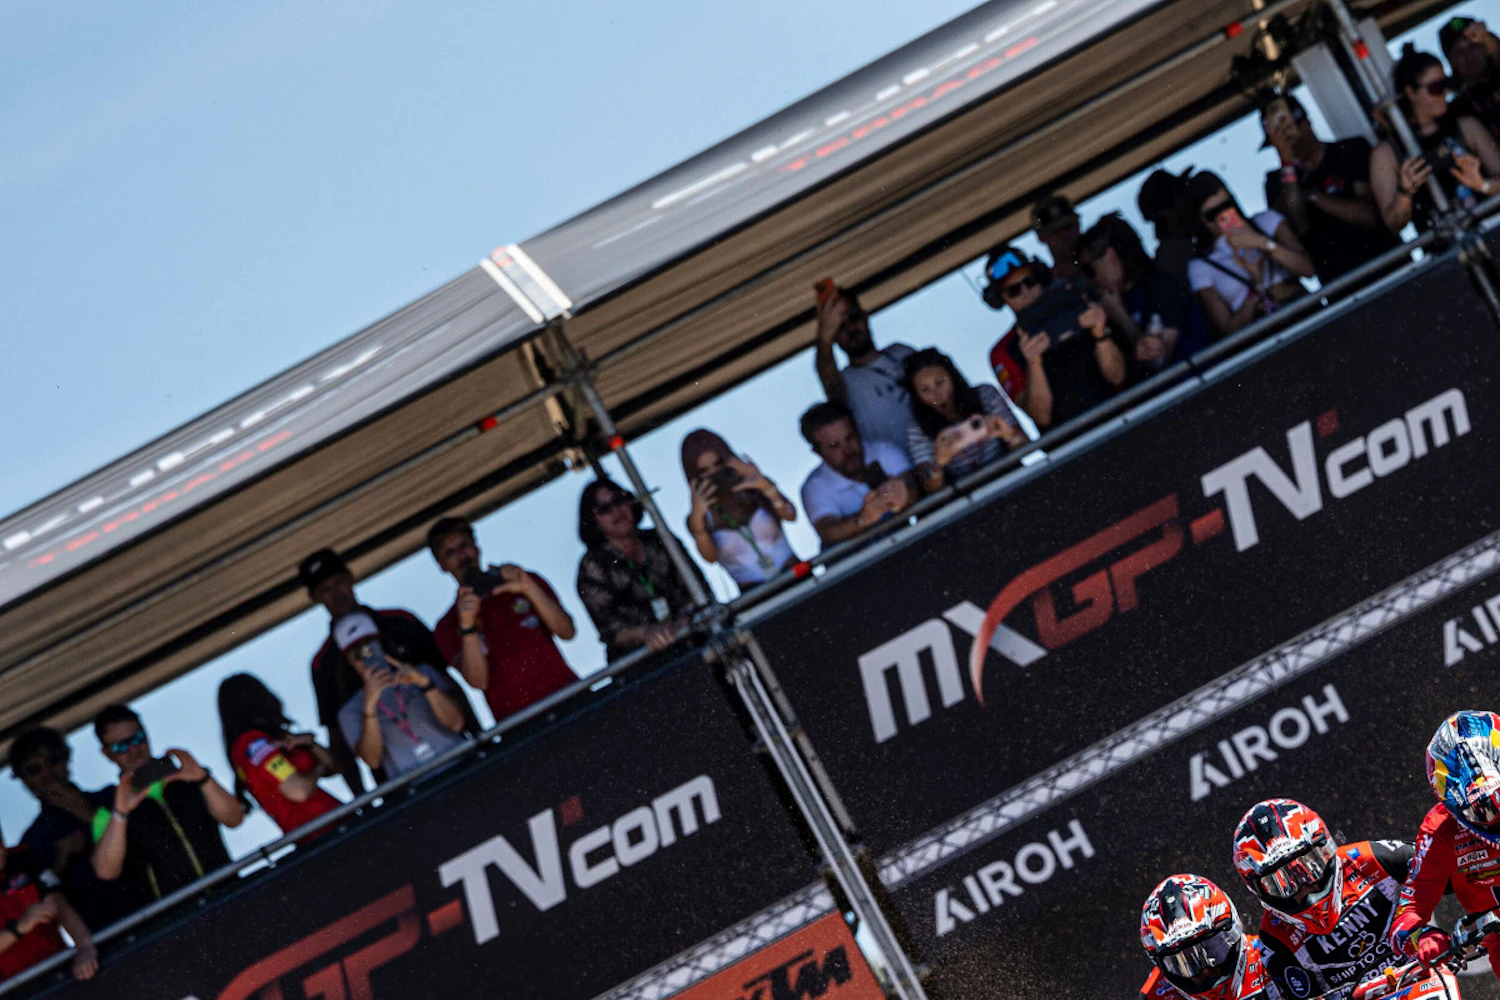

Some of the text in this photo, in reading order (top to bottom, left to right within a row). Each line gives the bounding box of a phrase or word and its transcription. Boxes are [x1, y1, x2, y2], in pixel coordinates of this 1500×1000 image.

[1189, 684, 1351, 801] AIROH
[933, 819, 1096, 937] AIROH
[1316, 898, 1380, 955] KENNY
[1359, 952, 1375, 967] TO
